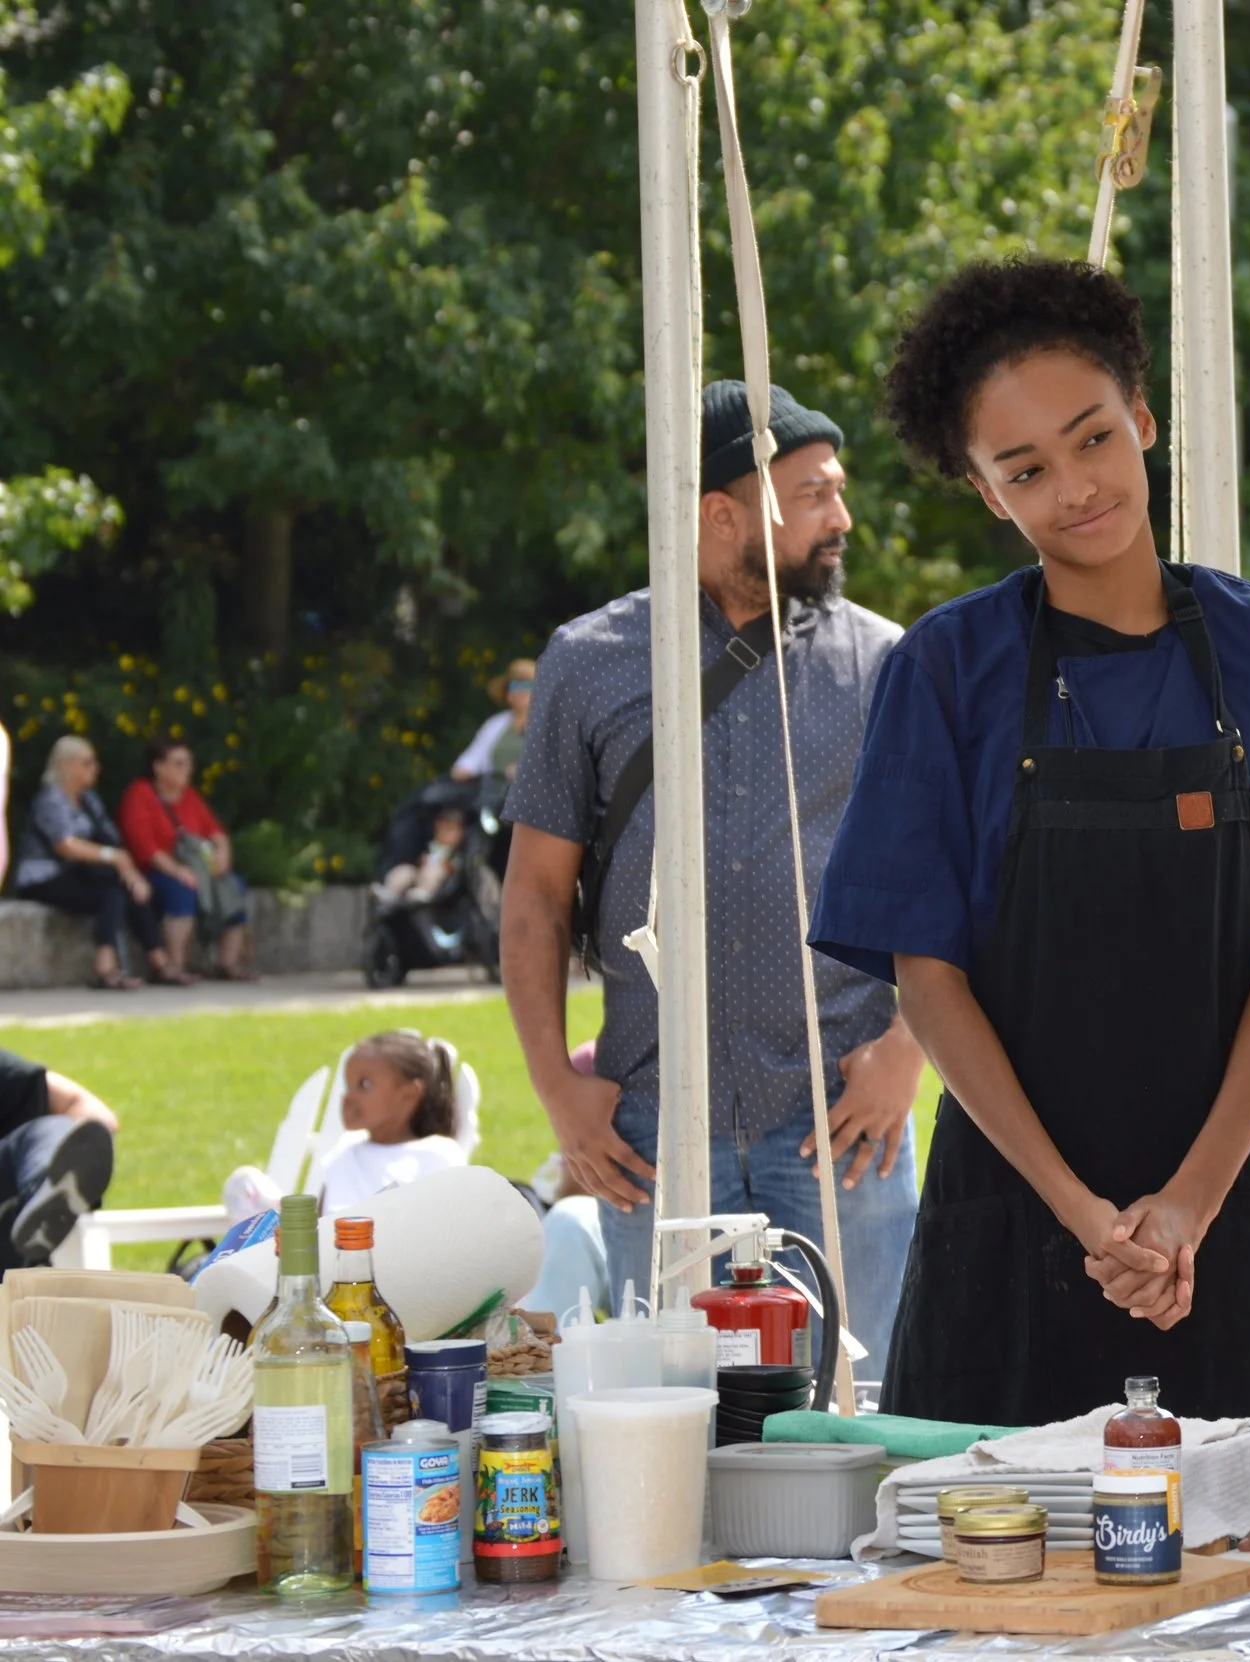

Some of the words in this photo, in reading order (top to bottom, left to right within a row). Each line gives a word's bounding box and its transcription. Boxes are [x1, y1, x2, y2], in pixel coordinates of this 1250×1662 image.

[420, 1455, 449, 1470] GOYA
[501, 1486, 540, 1503] JERK
[500, 1504, 542, 1518] Seasoning
[1095, 1514, 1168, 1553] Birdy's
